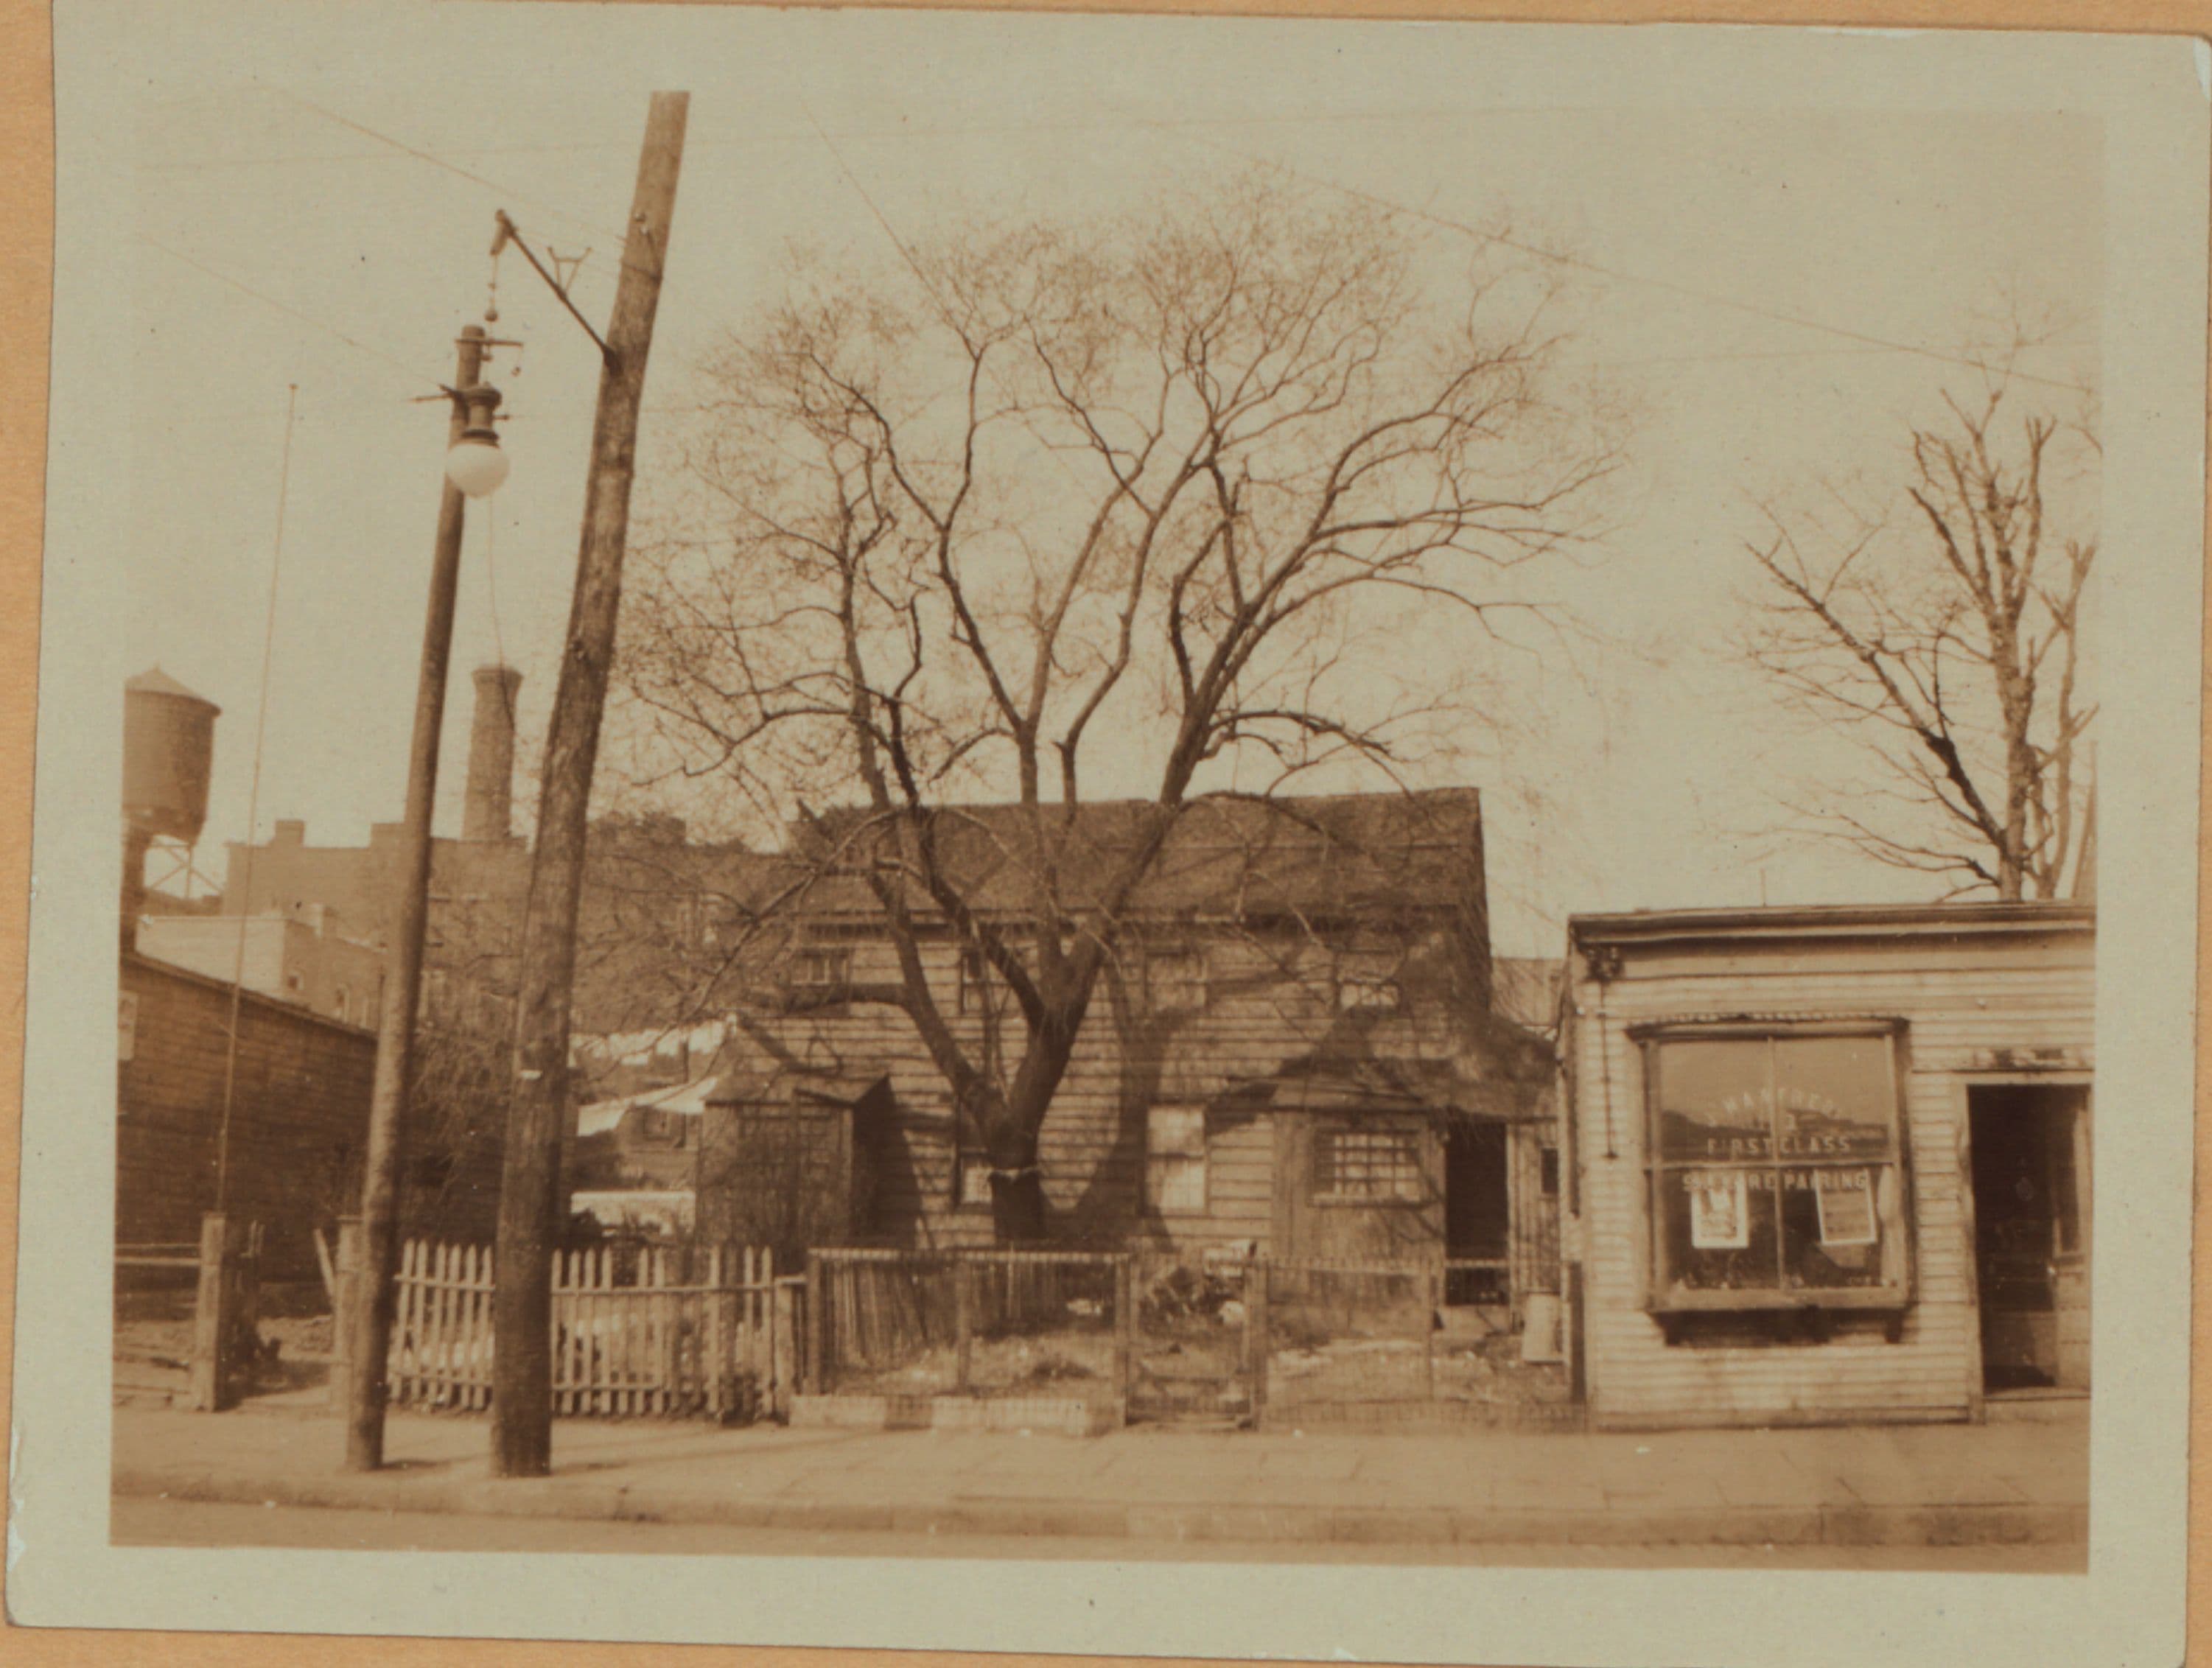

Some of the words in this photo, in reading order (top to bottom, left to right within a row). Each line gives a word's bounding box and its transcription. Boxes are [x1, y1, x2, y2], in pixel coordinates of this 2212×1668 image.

[1707, 1138, 1774, 1155] FIRST
[1779, 1136, 1851, 1154] CLASS
[1749, 1168, 1869, 1188] REPAIRING
